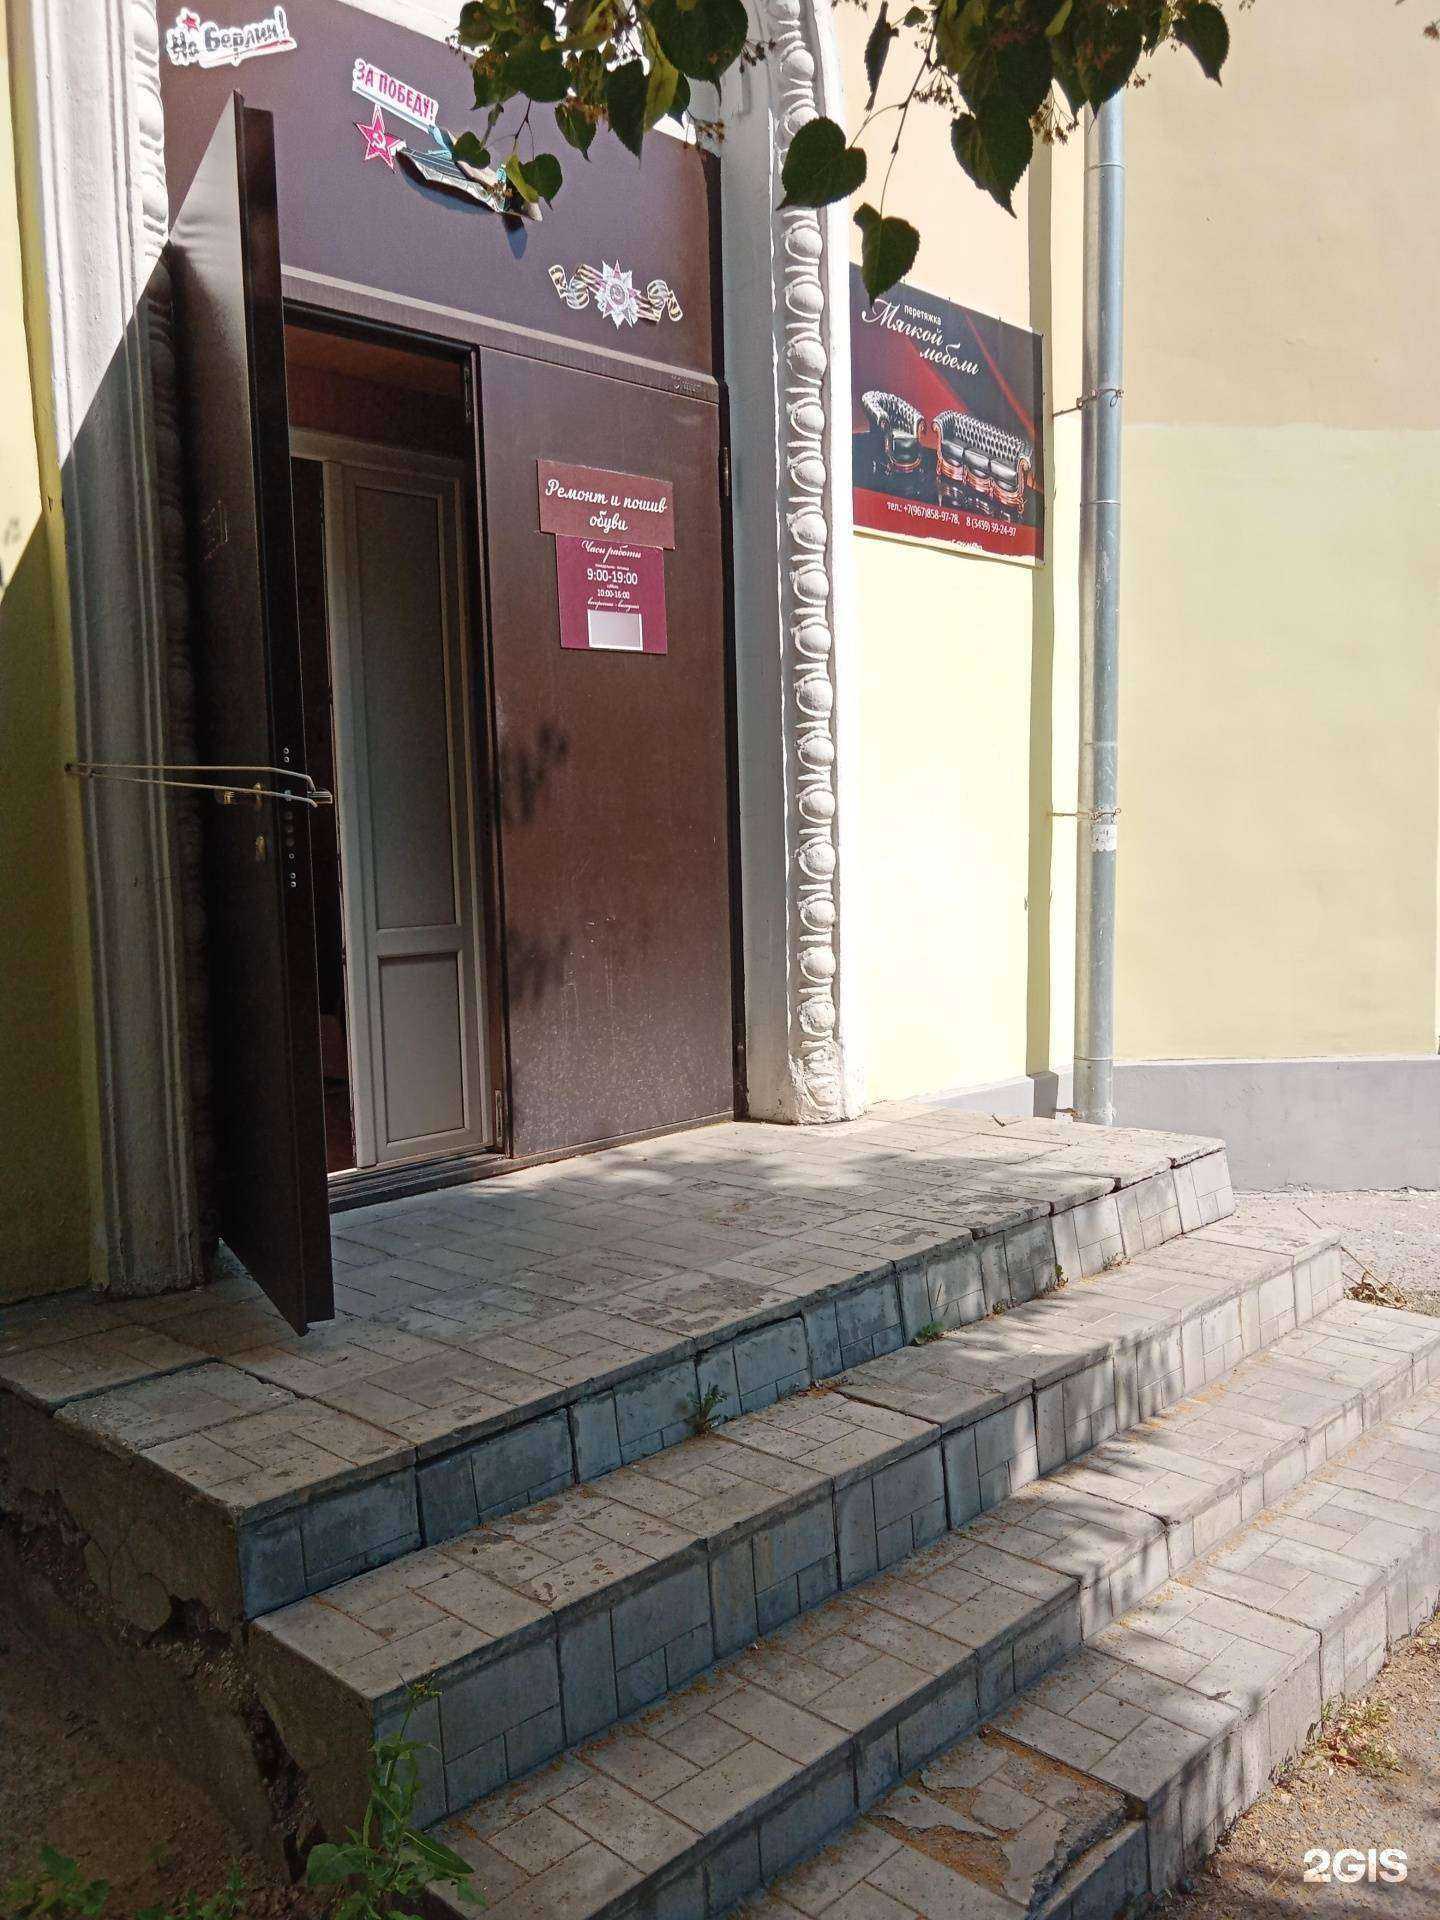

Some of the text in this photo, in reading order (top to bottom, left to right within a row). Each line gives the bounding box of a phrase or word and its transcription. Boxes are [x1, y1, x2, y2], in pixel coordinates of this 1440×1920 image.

[171, 30, 199, 58] На
[355, 62, 434, 121] ЗА ПОБЕДУ!
[861, 298, 944, 346] Мягкой
[904, 304, 942, 326] перетяжка
[920, 342, 980, 375] мебели
[545, 479, 668, 513] Ремонт и пошив
[589, 510, 628, 534] обуви
[581, 540, 641, 564] Часы работы
[587, 568, 638, 585] 9:00-19:00
